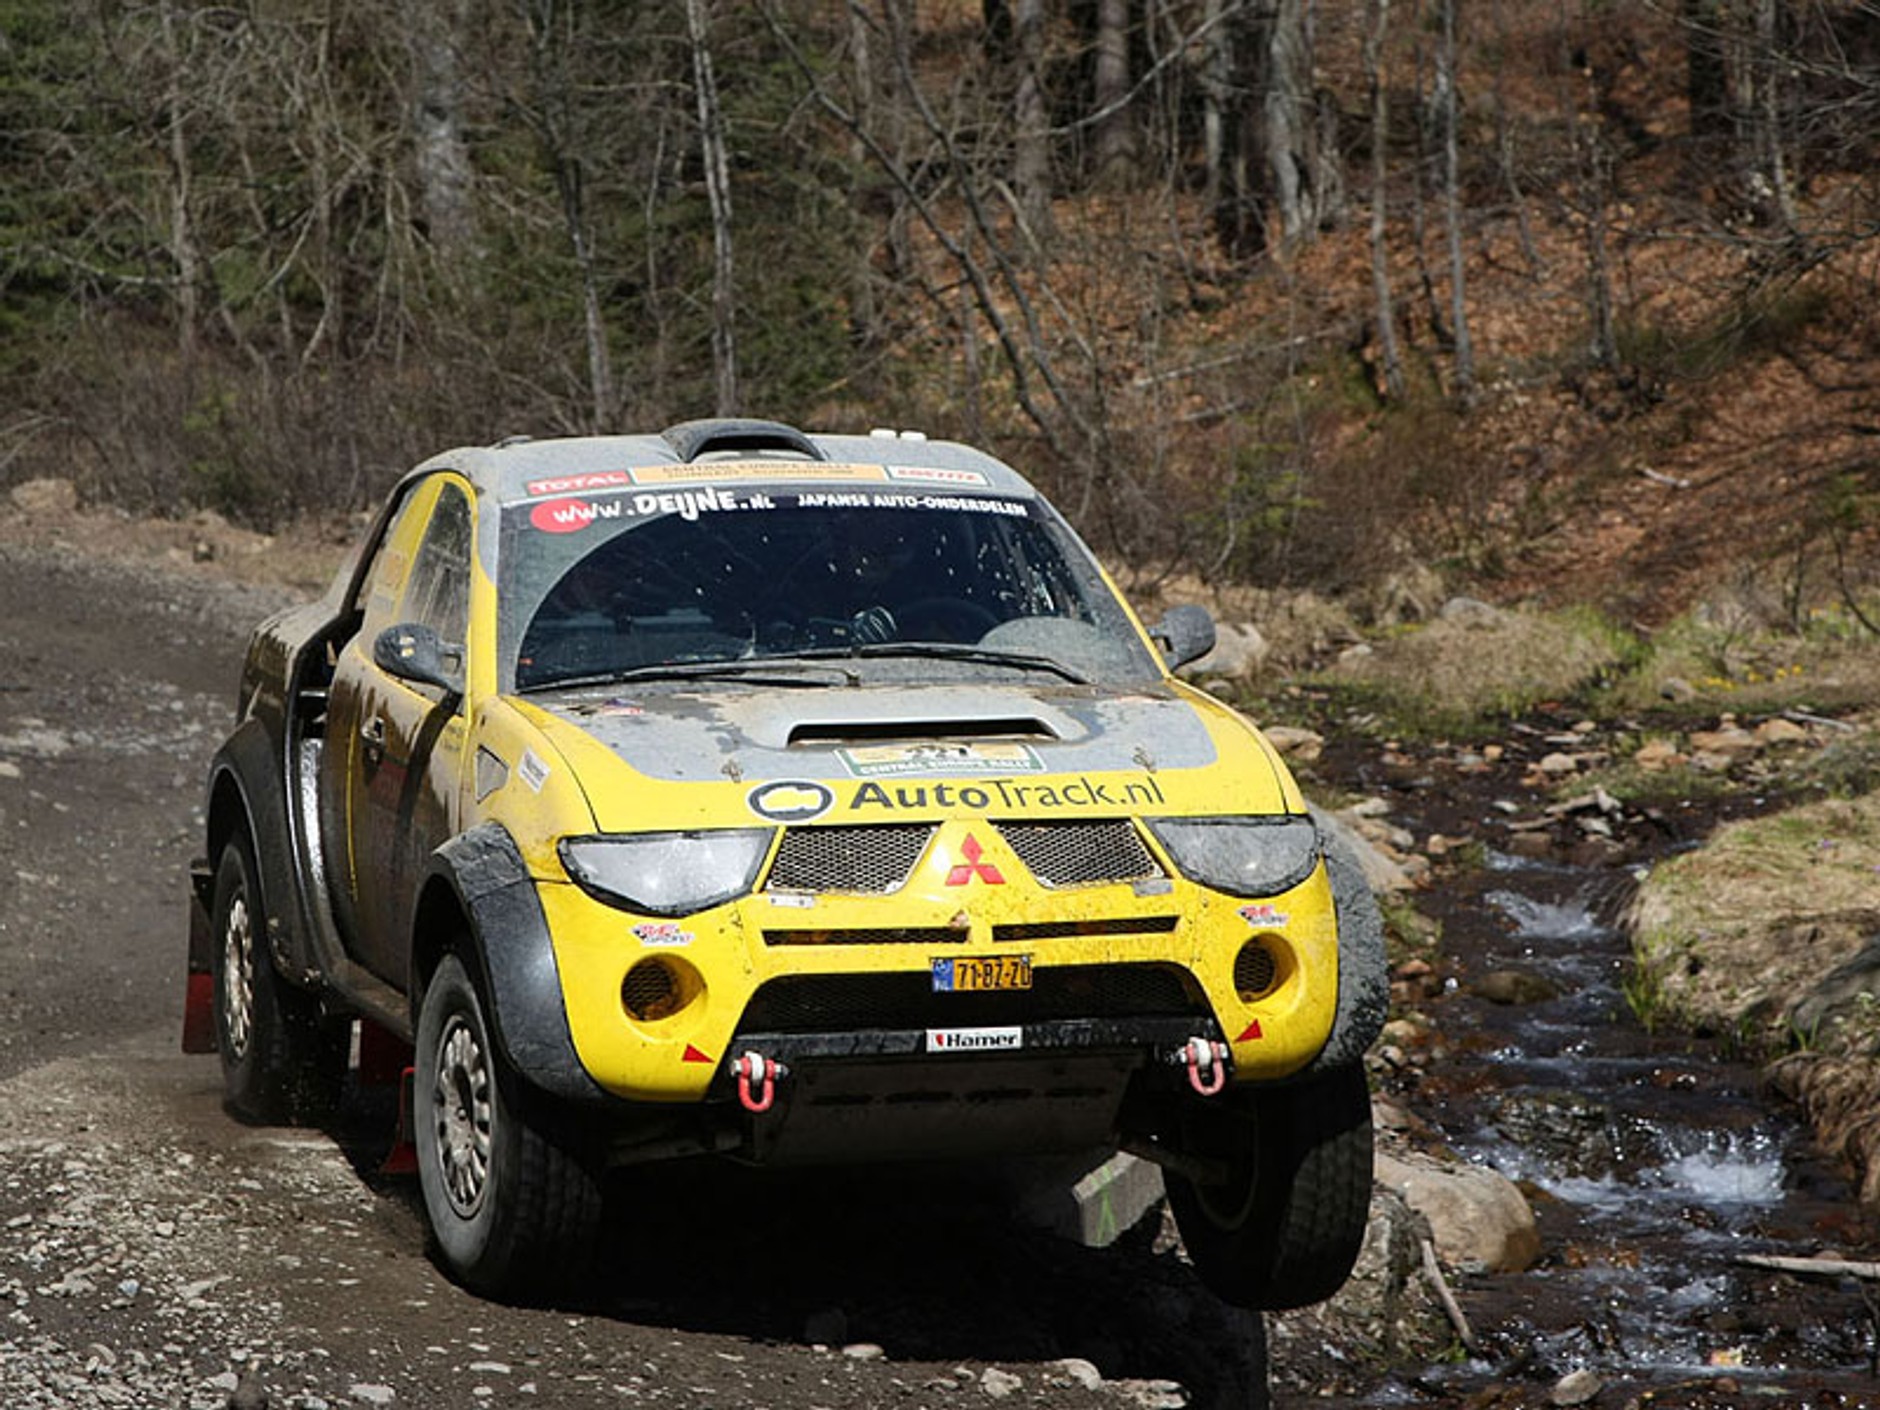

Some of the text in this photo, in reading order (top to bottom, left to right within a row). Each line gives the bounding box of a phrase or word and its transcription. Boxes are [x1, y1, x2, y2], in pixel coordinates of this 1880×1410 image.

[529, 473, 626, 493] TOTAL
[798, 494, 1028, 517] JAPANSE AUTO-ONDERDELEN
[849, 776, 1165, 810] AutoTrack.nl
[946, 1034, 1017, 1047] Hamer
